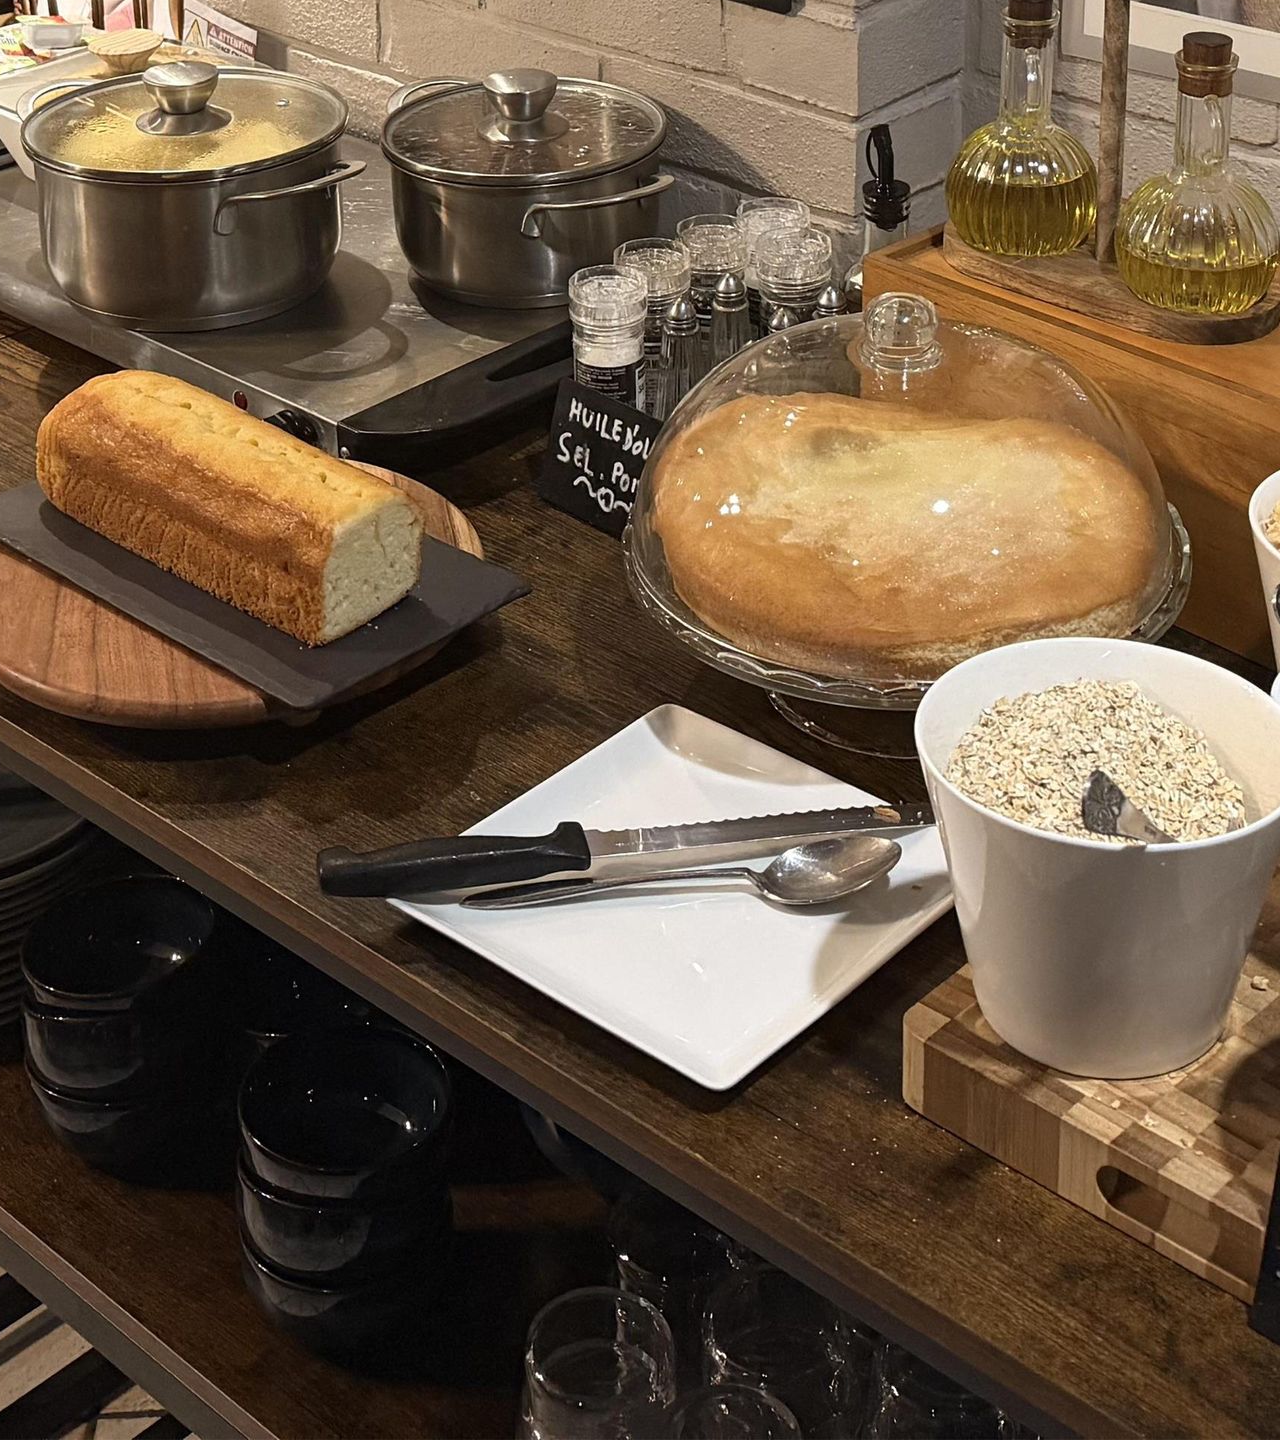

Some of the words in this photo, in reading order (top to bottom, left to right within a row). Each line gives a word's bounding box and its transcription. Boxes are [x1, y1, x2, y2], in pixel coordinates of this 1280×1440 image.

[556, 431, 594, 480] SEL
[568, 397, 623, 444] HUILE
[621, 424, 652, 461] D'OL
